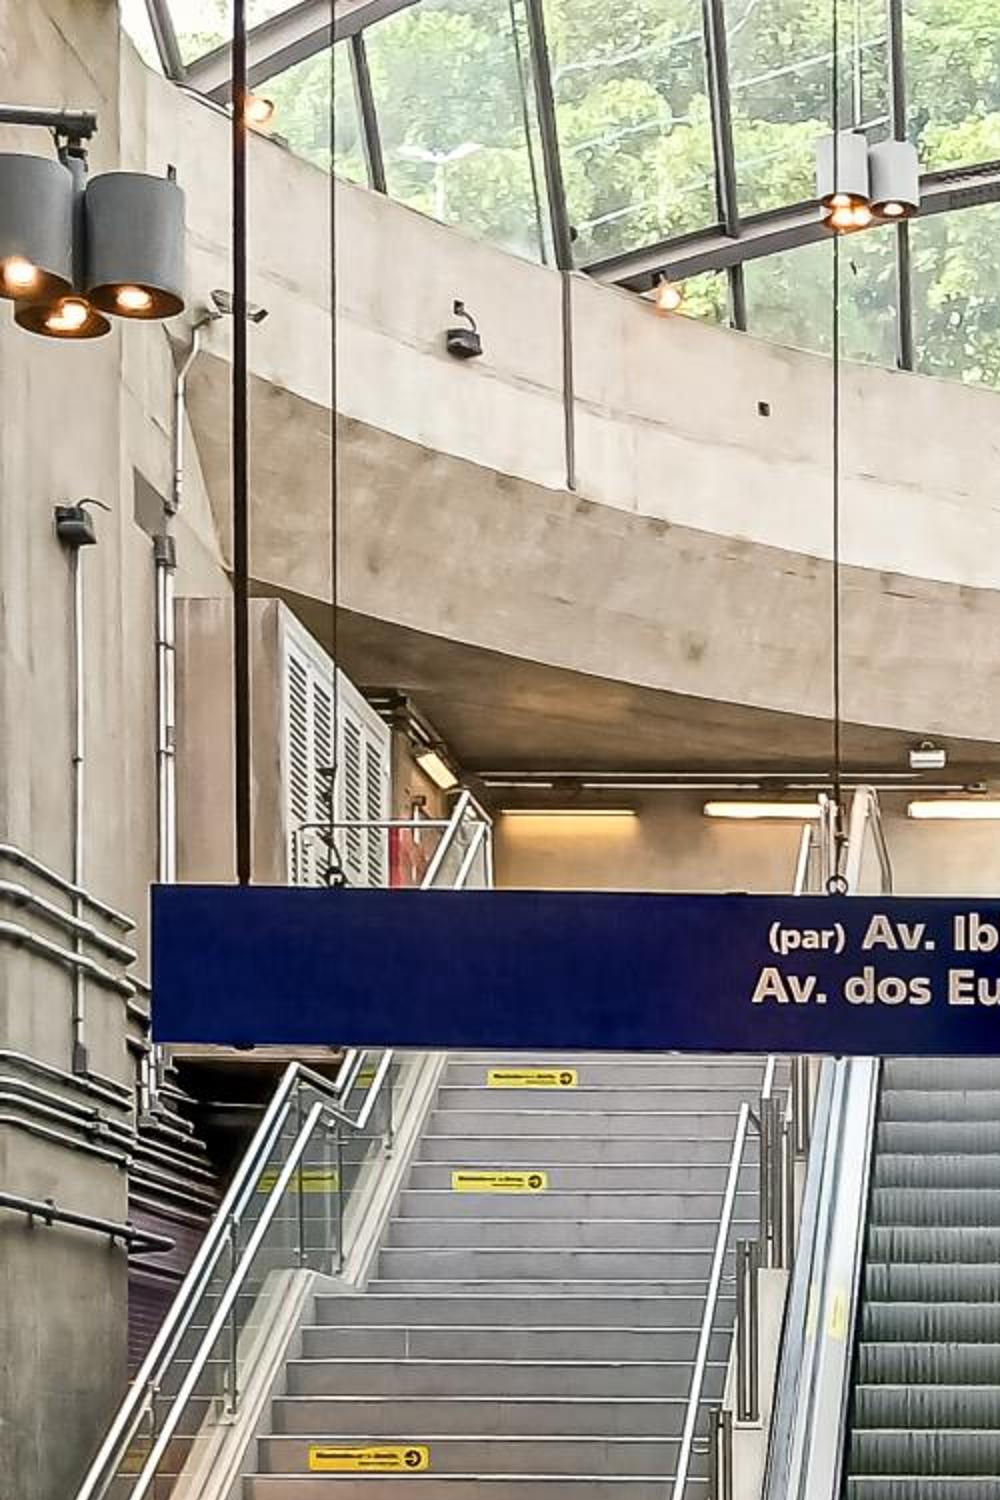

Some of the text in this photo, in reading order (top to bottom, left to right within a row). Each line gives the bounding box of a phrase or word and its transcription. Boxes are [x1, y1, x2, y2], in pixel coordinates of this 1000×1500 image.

[767, 921, 846, 955] (par)
[862, 914, 935, 951] Av.
[751, 967, 827, 1004] Av.
[845, 966, 932, 1005] dos
